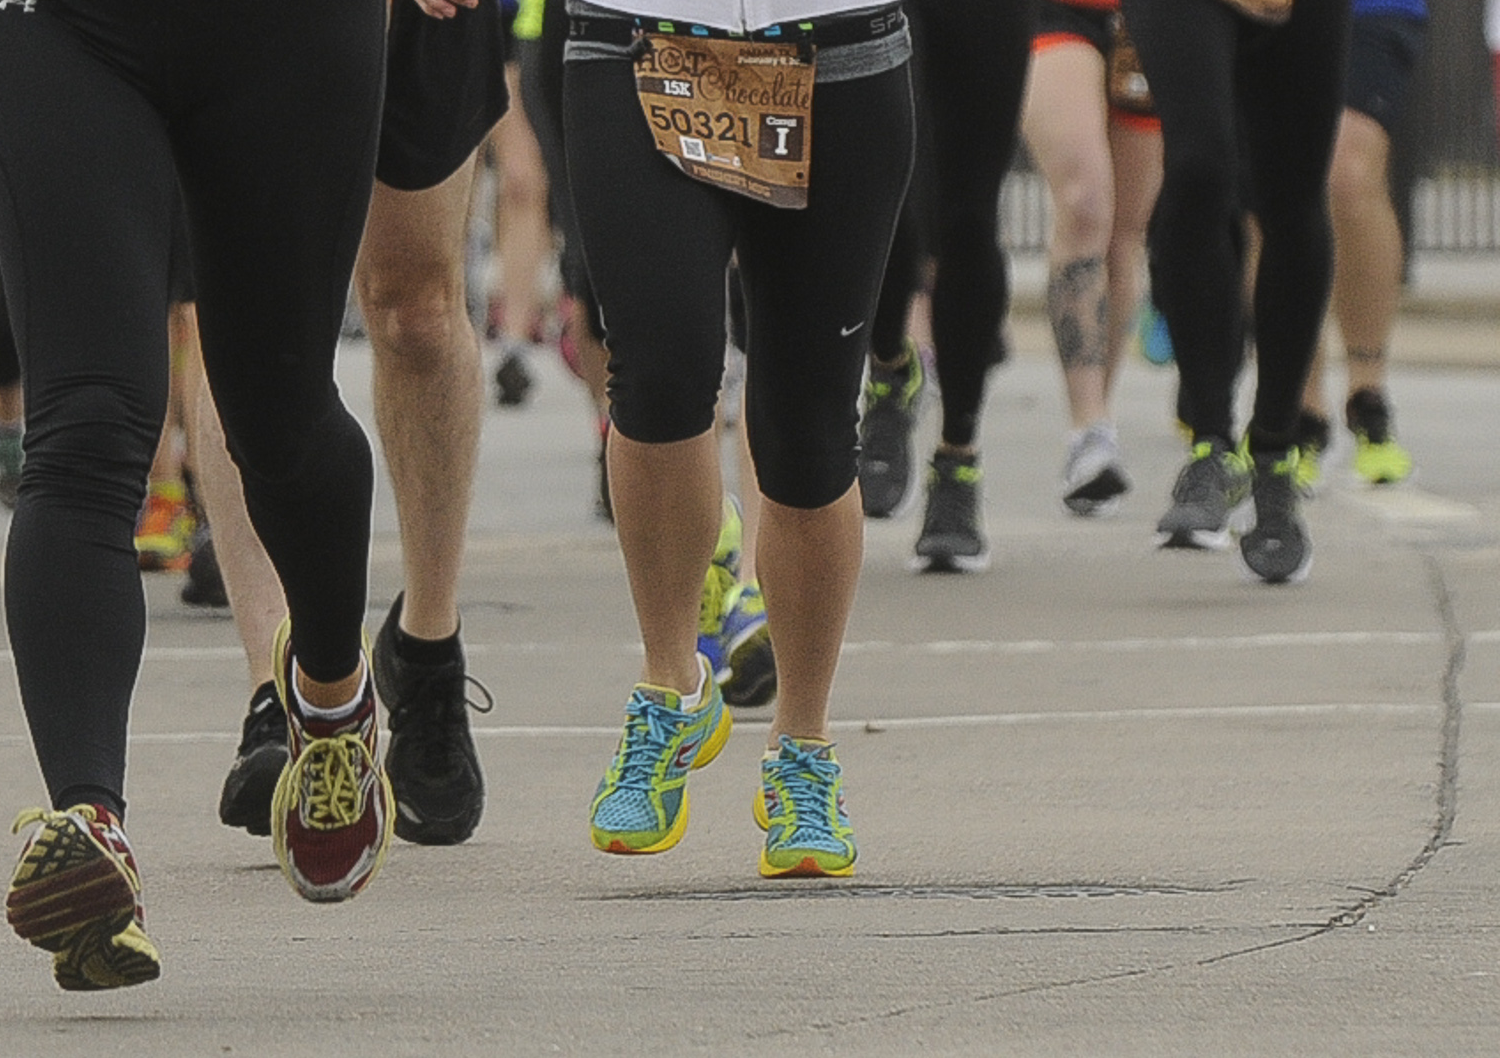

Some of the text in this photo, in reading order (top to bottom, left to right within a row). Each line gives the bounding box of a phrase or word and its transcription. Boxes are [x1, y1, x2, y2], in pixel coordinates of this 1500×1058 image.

[663, 79, 691, 97] 15K
[698, 65, 811, 112] Chocolate
[650, 104, 753, 149] 50321
[773, 128, 790, 155] I
